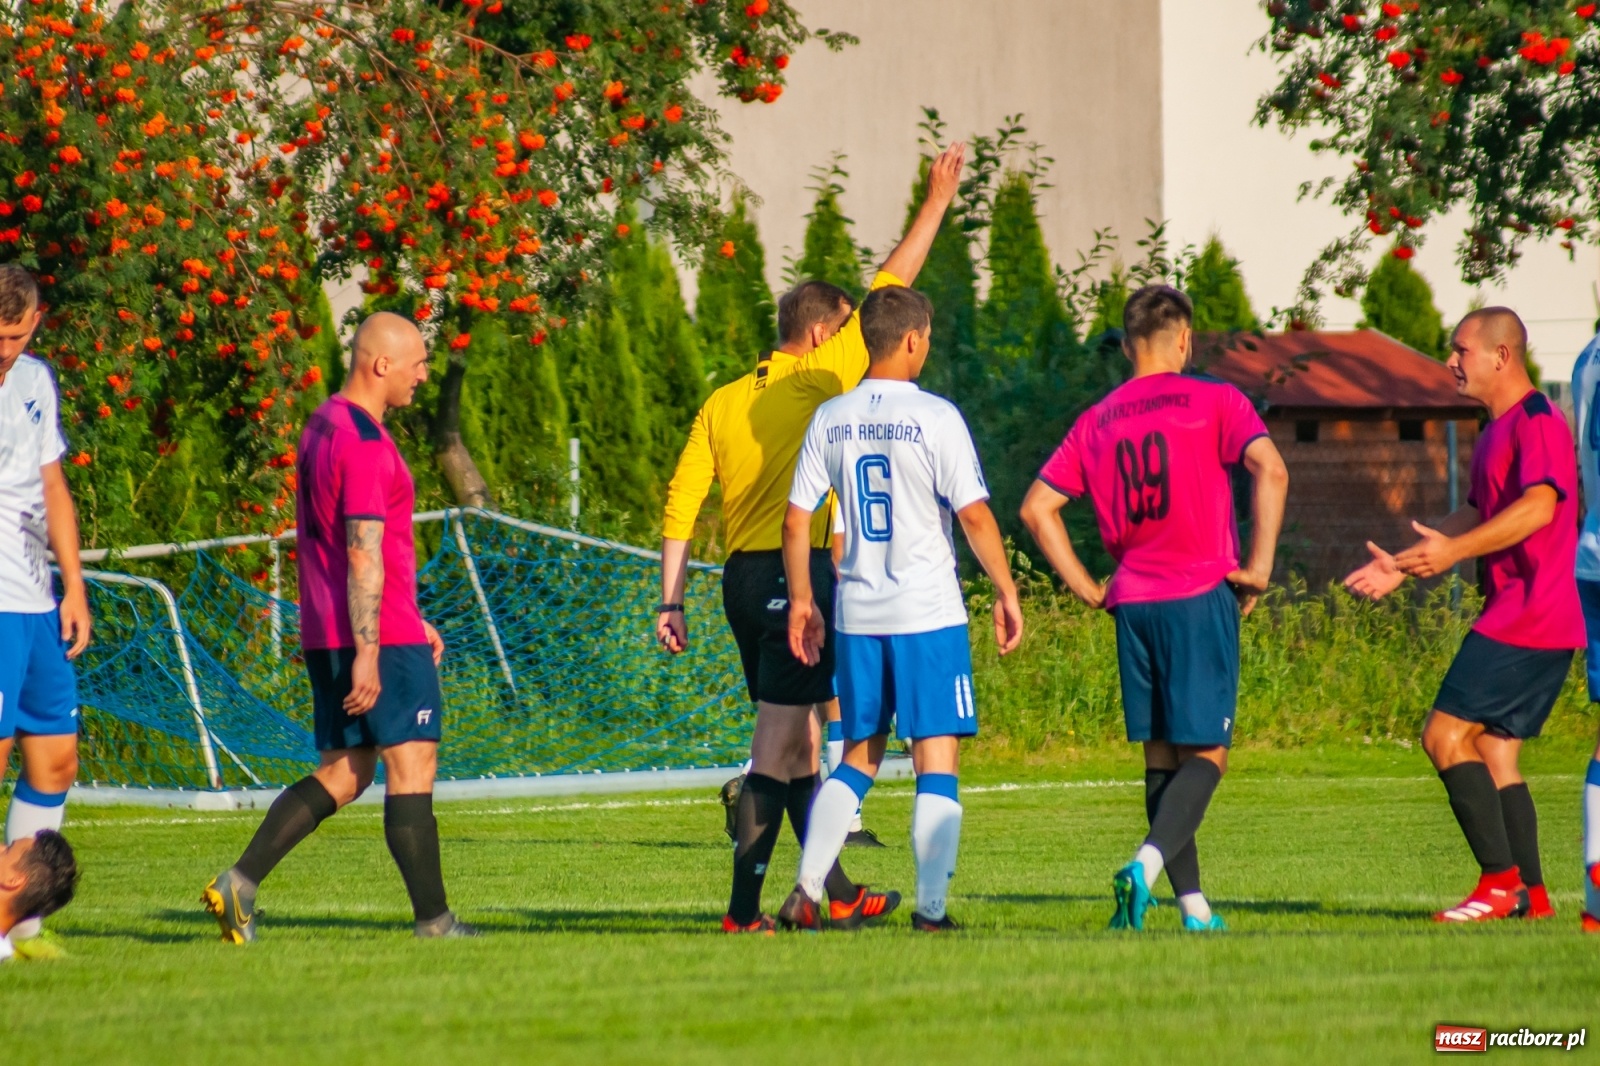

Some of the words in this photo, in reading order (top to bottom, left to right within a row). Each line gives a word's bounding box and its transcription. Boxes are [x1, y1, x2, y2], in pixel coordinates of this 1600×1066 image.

[826, 423, 852, 444] UNIA
[858, 419, 921, 443] RACIBÓRZ
[855, 453, 893, 542] 6
